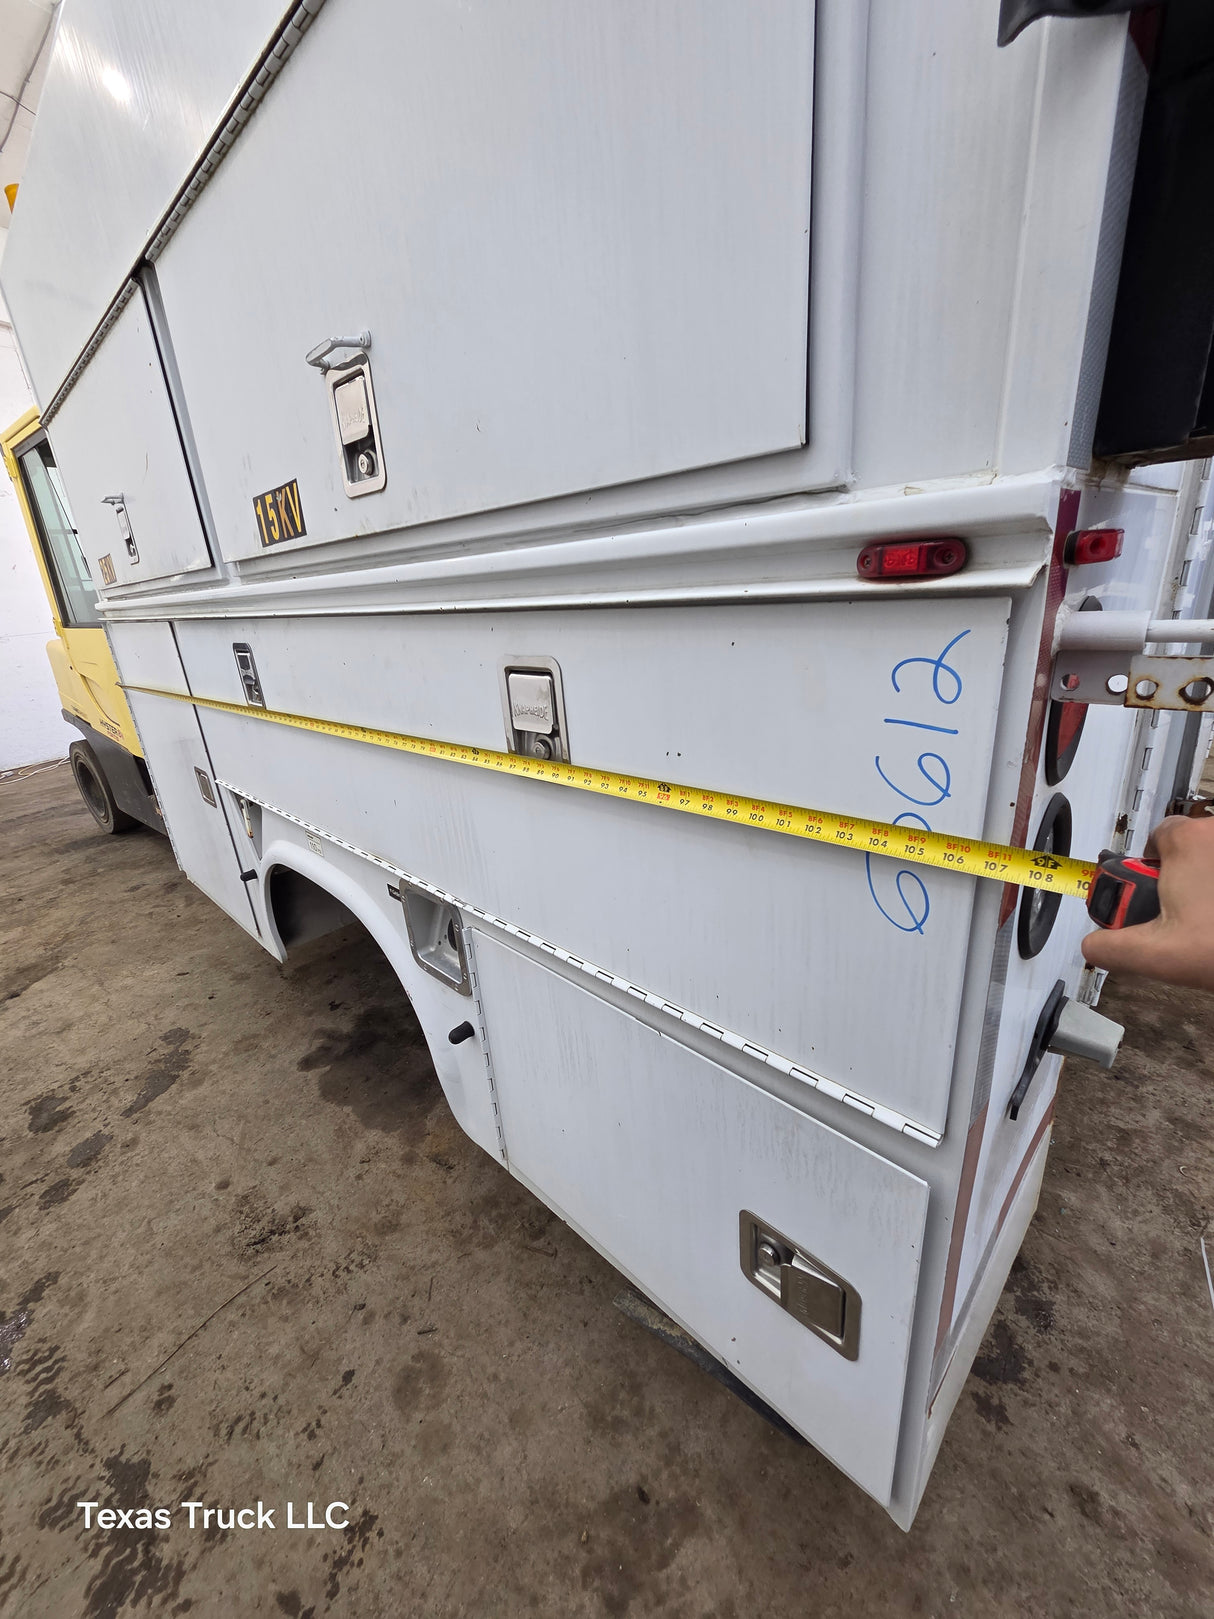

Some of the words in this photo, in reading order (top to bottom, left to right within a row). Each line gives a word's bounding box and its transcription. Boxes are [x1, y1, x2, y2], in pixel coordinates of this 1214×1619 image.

[256, 482, 302, 544] 15KV
[702, 803, 713, 811] 98
[726, 808, 738, 816] 99
[749, 813, 764, 822] 100
[776, 818, 791, 828] 101
[805, 824, 822, 834] 102
[836, 830, 853, 840] 103
[868, 837, 888, 848] 104
[904, 845, 925, 856] 105
[943, 852, 964, 864] 106
[984, 861, 1008, 873] 107
[1028, 870, 1054, 882] 108
[1077, 880, 1090, 890] 10
